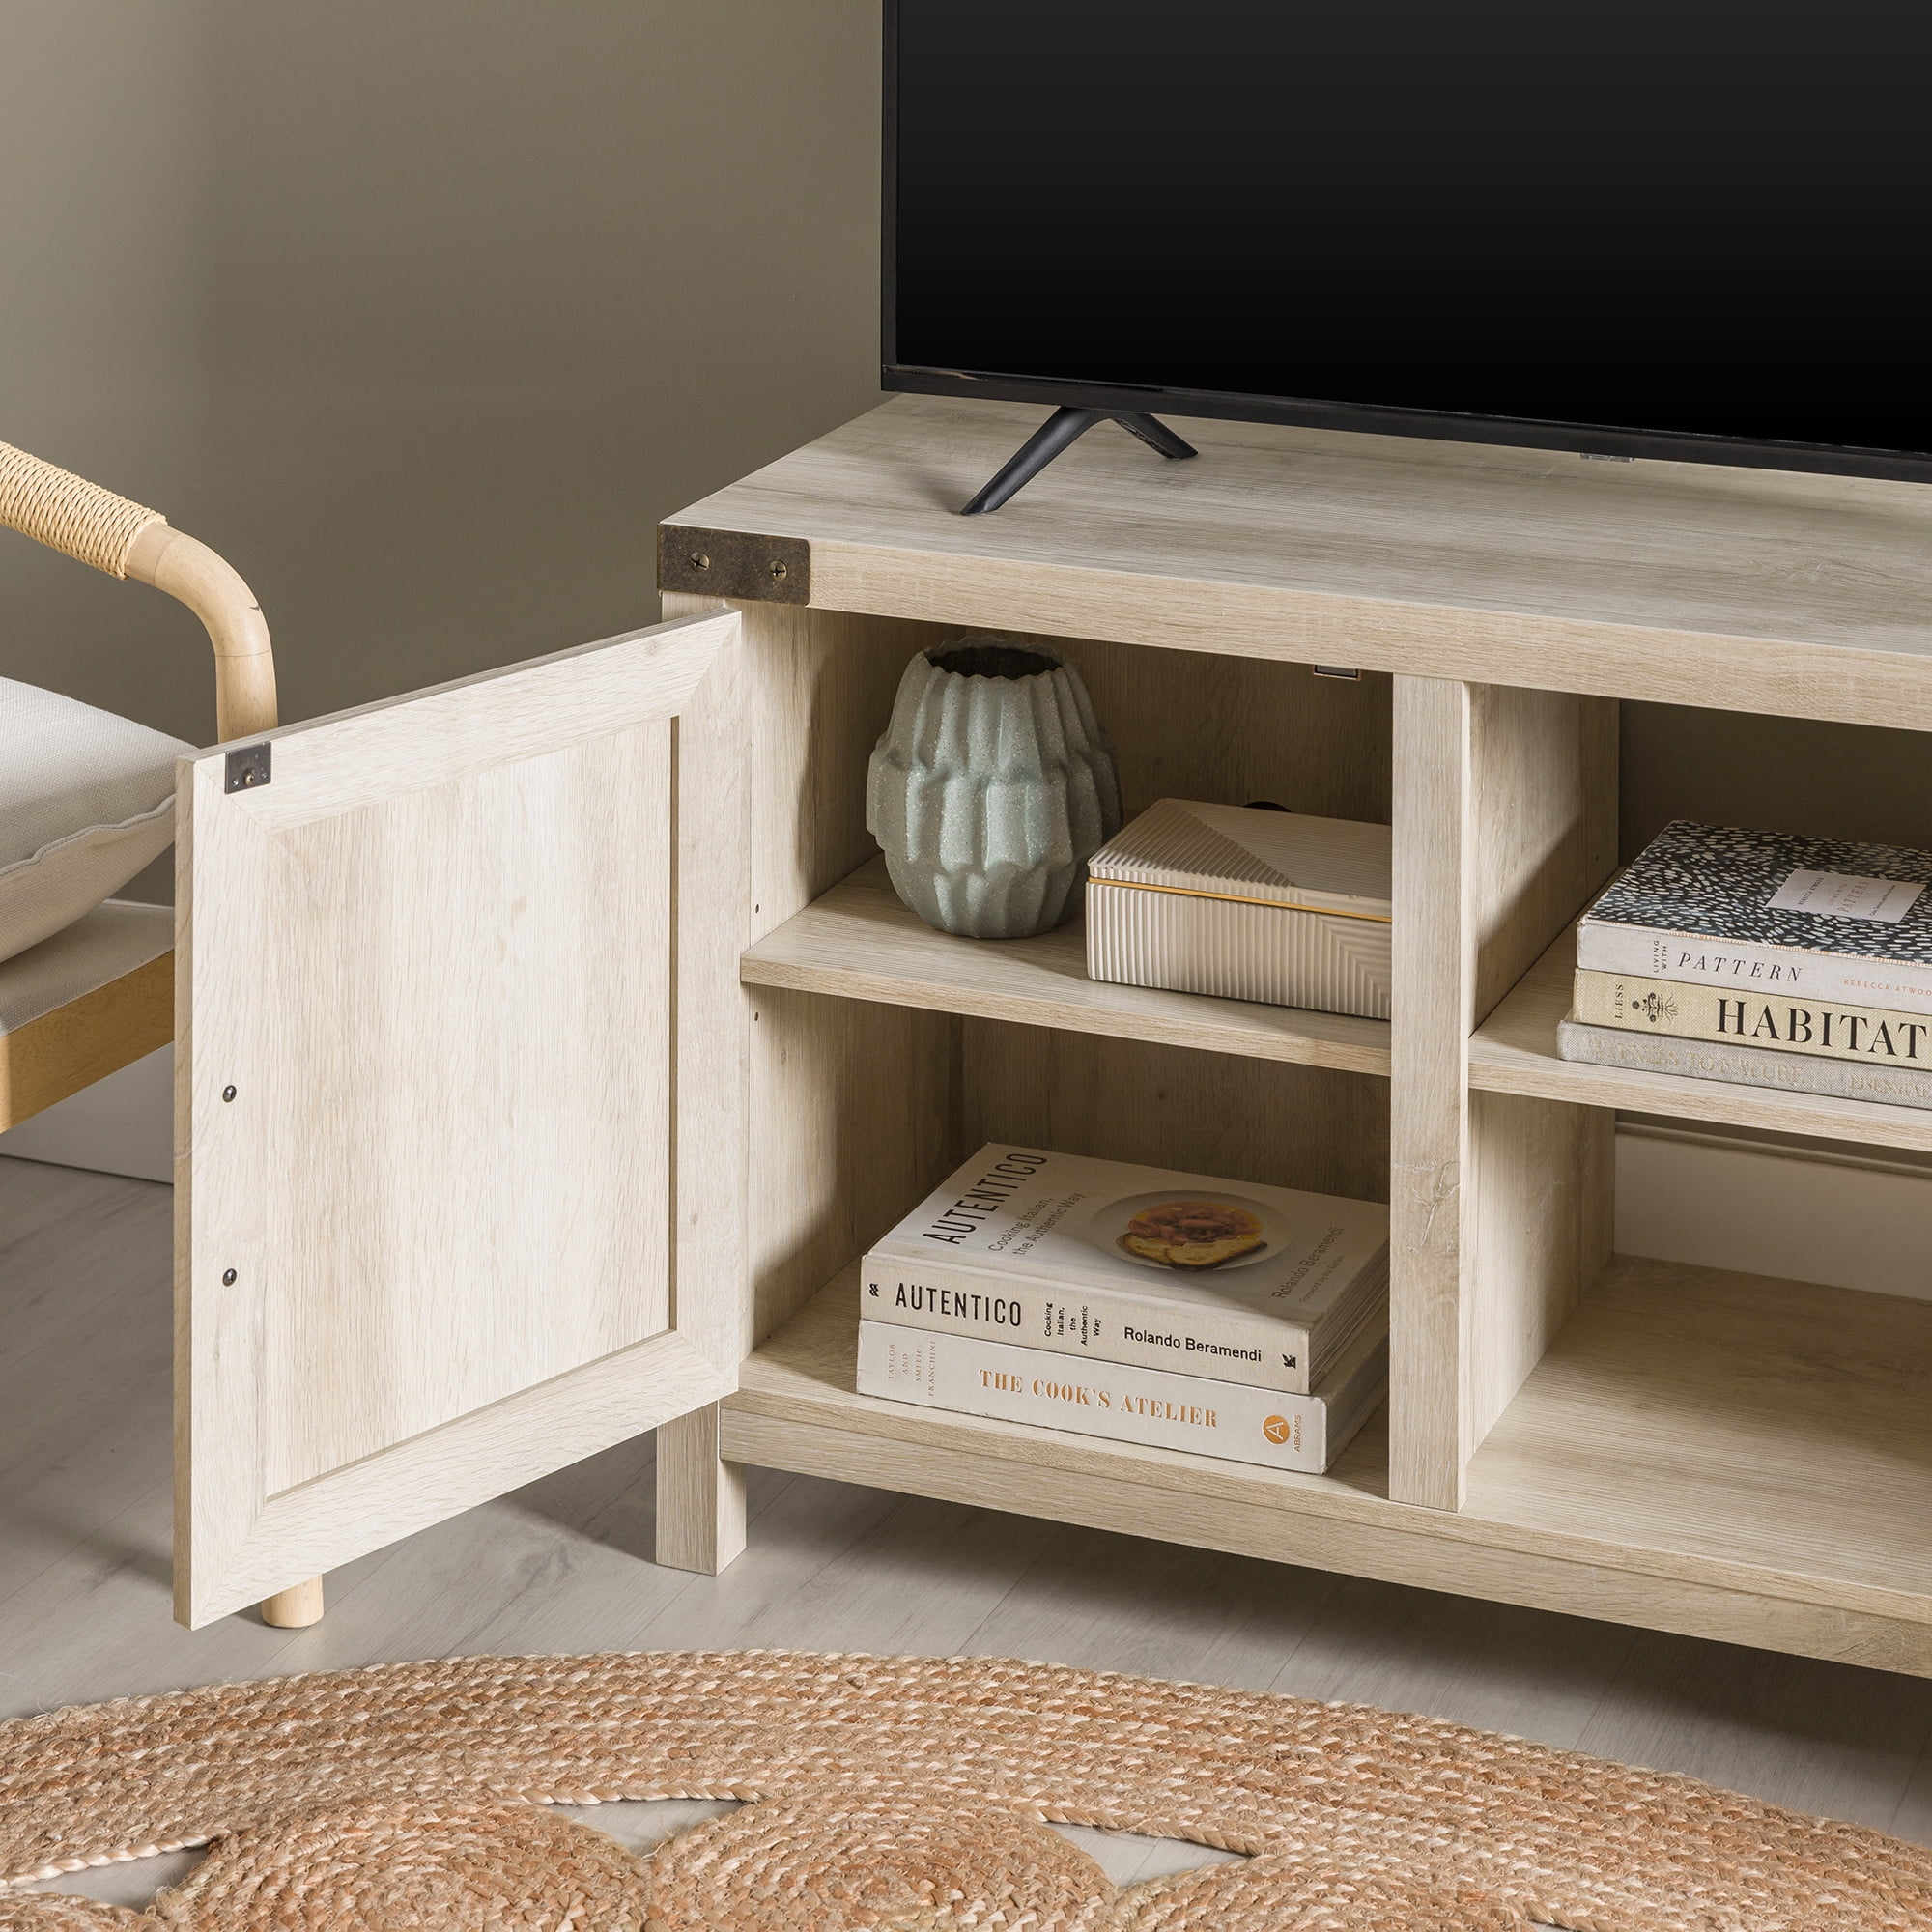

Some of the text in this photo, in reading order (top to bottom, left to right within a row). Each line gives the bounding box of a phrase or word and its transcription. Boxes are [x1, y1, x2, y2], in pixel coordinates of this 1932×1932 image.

[1677, 952, 1803, 982] PATTERN
[1843, 978, 1890, 991] REBECCA
[1614, 984, 1624, 1019] LIESS
[1716, 998, 1927, 1059] HABITAT
[923, 1153, 1047, 1244] AUTENTICO
[988, 1198, 1055, 1251] Cooking Italian,
[1012, 1192, 1086, 1255] the Authentic Way
[1271, 1266, 1309, 1299] Rolando
[1298, 1226, 1345, 1267] Beramendi
[895, 1283, 1021, 1327] AUTENTICO
[1044, 1302, 1053, 1337] Cooking
[1080, 1306, 1089, 1346] Authentic
[1093, 1318, 1101, 1337] Way
[1124, 1326, 1262, 1362] Rolando Beramendi
[927, 1341, 936, 1397] FRANCHINI
[979, 1369, 1217, 1428] THE COOK'S ATELIER
[1265, 1421, 1284, 1440] A
[1293, 1414, 1302, 1453] ABRAMS
